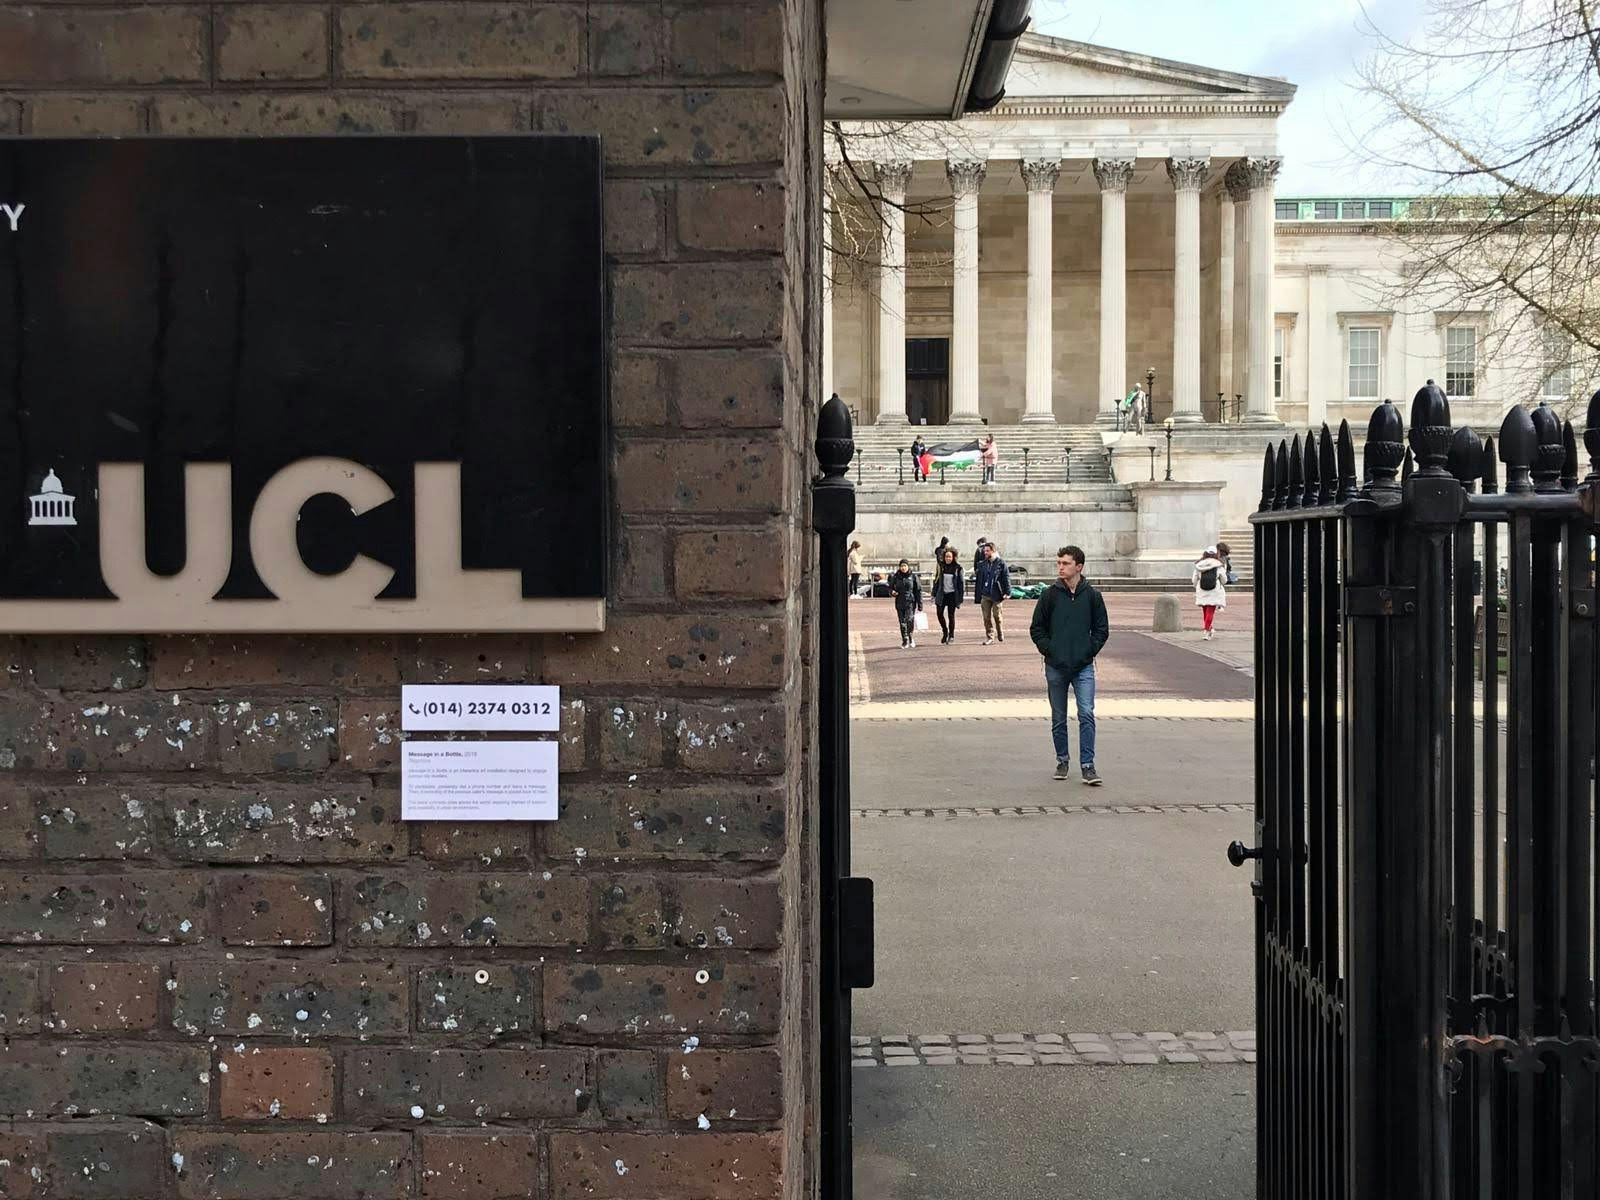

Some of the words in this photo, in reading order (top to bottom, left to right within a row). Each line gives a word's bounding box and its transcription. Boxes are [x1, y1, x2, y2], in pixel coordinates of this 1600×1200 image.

[0, 203, 26, 231] Y
[98, 455, 523, 601] UCL
[423, 702, 463, 717] (014)
[468, 702, 506, 715] 2374
[511, 702, 551, 715] 0312
